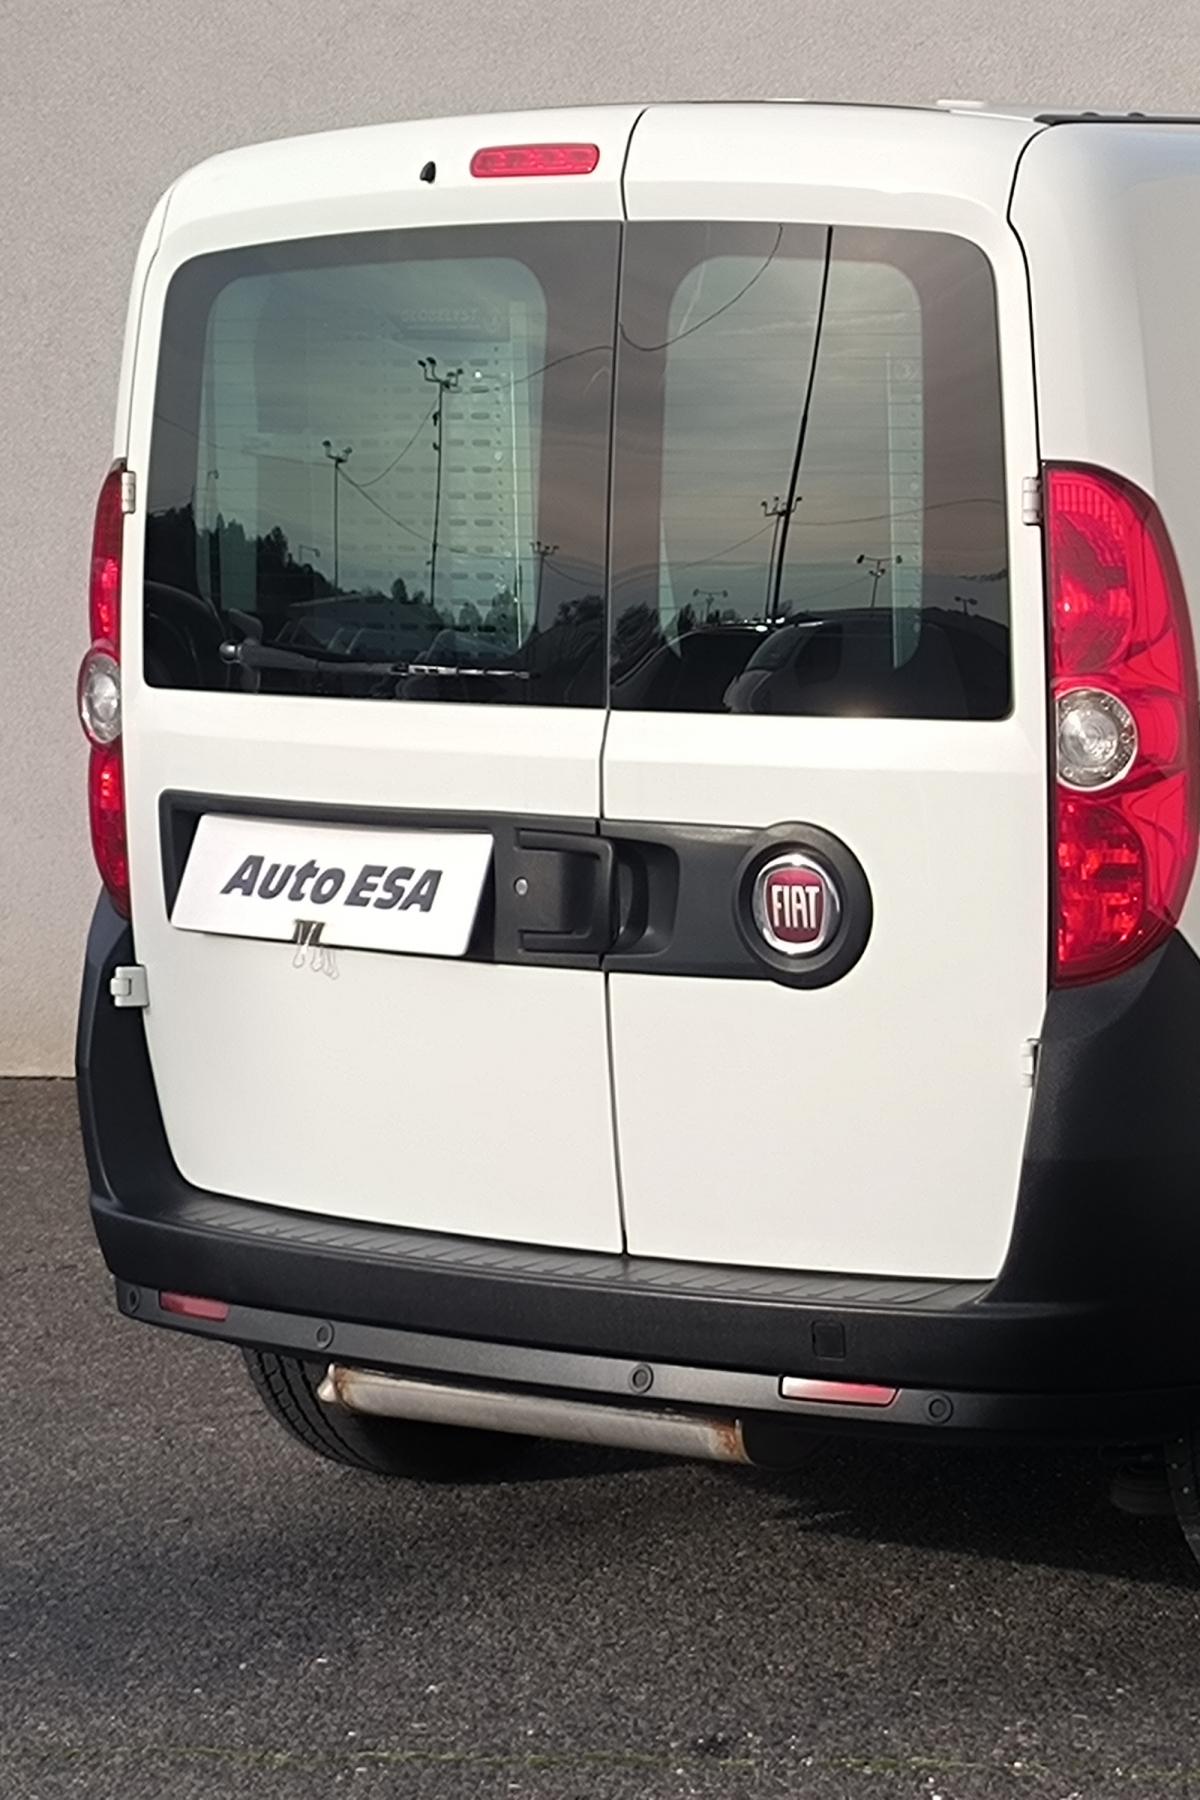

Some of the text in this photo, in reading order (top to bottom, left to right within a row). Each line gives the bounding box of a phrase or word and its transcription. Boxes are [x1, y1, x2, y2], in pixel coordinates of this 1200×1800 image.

[219, 855, 443, 912] Auto ESA
[772, 884, 819, 929] FIAT
